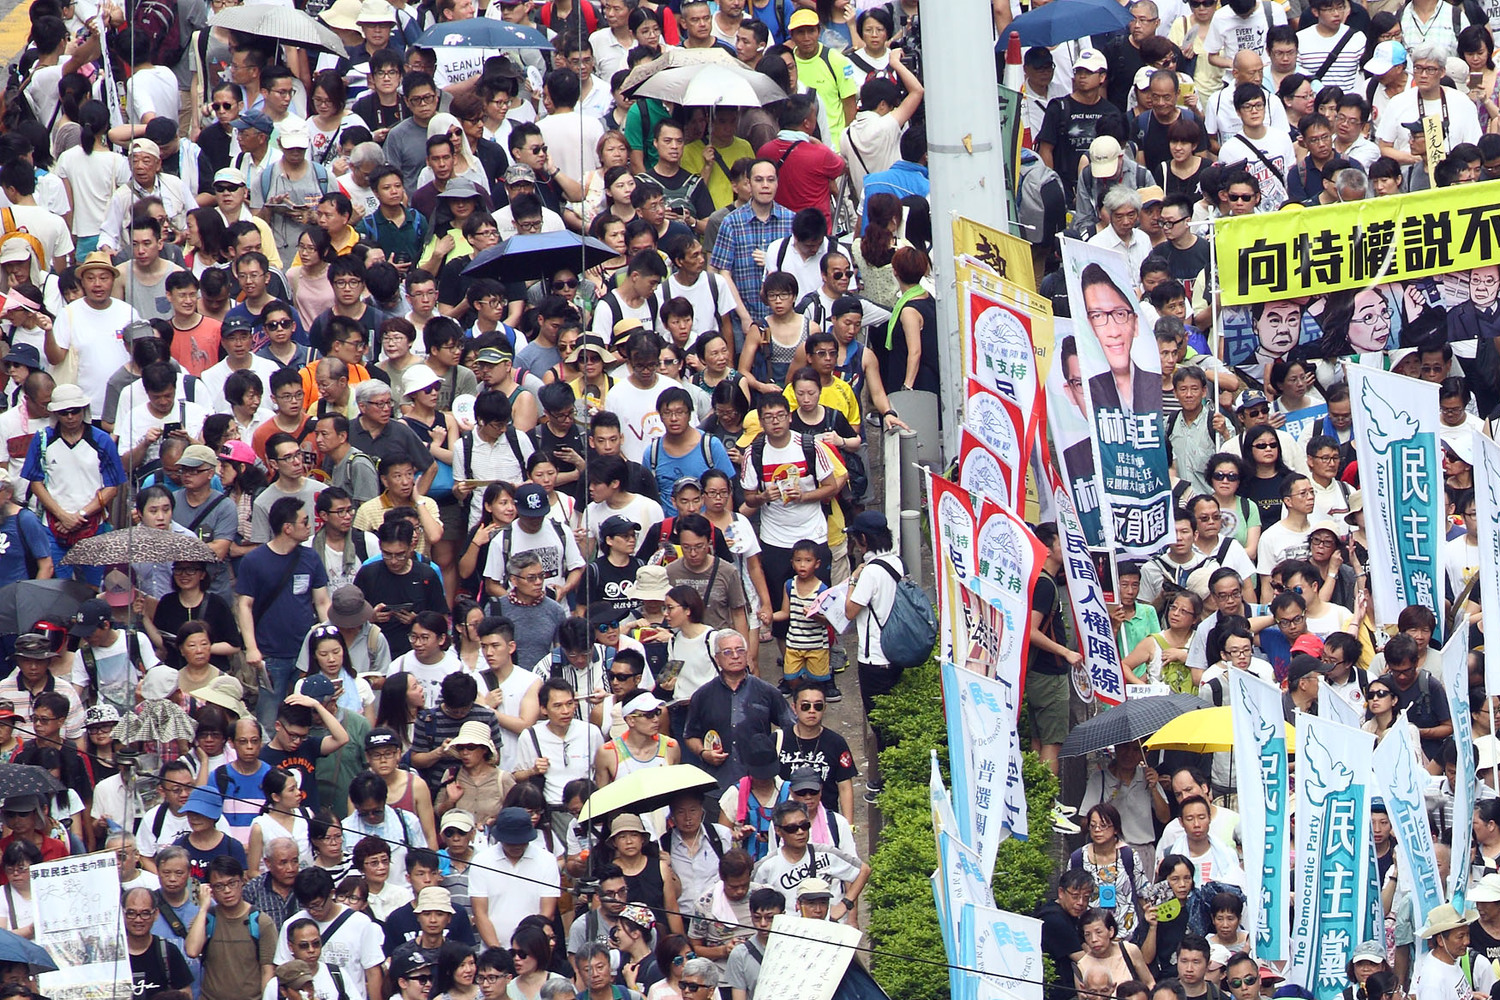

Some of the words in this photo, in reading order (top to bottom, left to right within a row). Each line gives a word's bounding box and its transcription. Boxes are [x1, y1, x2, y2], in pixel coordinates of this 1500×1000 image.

[1400, 446, 1438, 622] 民主黨
[1065, 533, 1121, 696] 民間人權陣線
[1307, 814, 1321, 853] Party
[1317, 798, 1356, 990] 民主黨
[1293, 946, 1307, 967] The
[1296, 859, 1317, 946] Democratic
